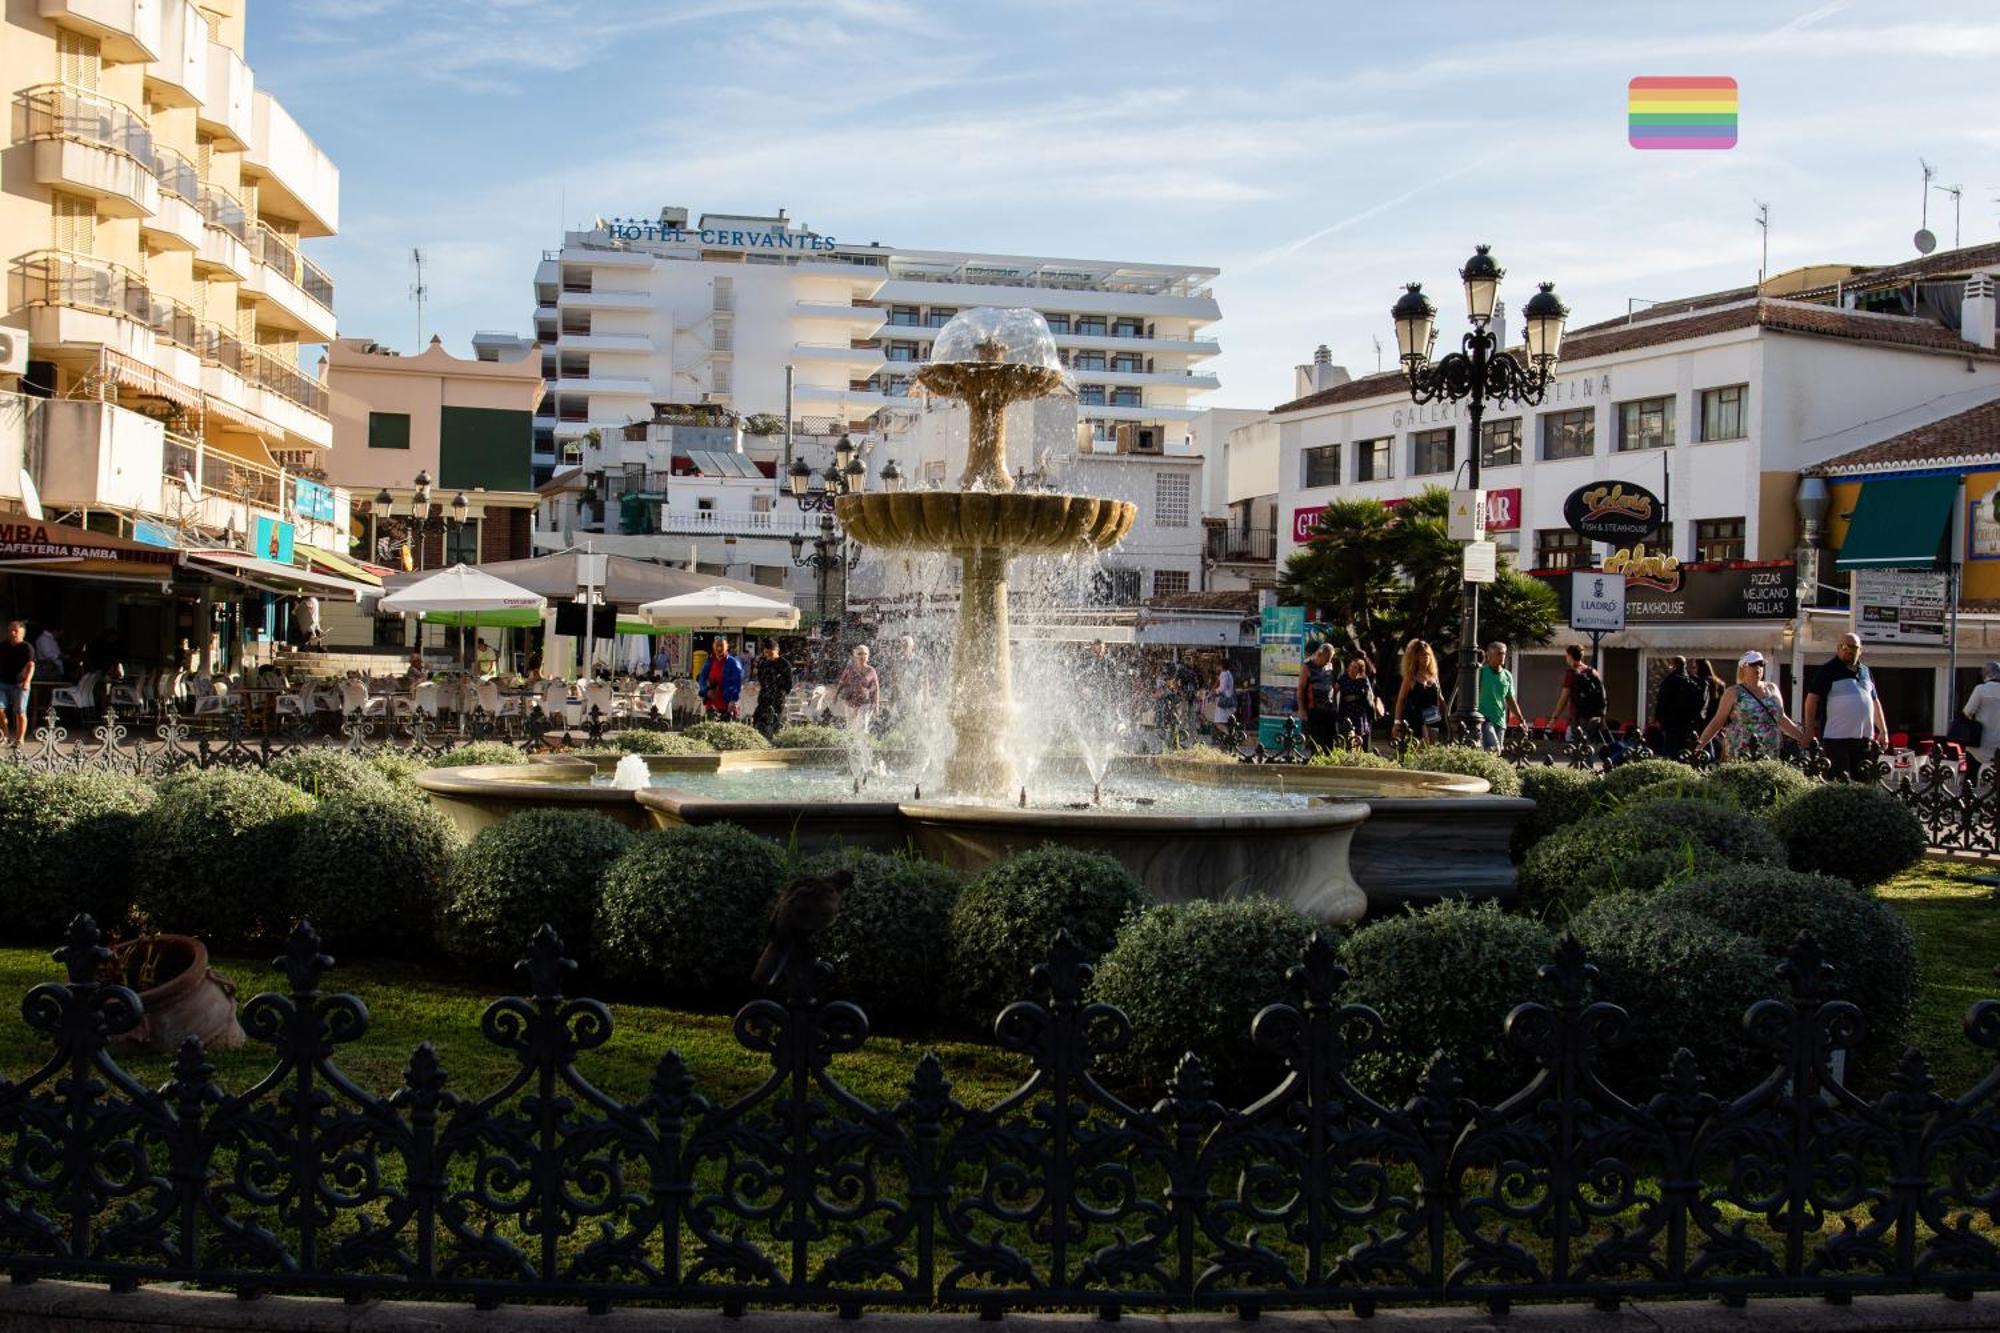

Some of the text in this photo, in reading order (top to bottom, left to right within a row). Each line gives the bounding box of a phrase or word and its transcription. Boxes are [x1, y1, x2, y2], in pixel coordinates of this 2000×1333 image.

[609, 224, 836, 251] HOTEL CERVANTES
[1604, 524, 1648, 533] STEAKHOUSE
[72, 548, 118, 560] SAMBA
[1751, 573, 1781, 585] PIZZAS
[1743, 587, 1789, 600] MEJICANO
[1626, 601, 1685, 615] STEAKHOUSE
[1747, 602, 1784, 614] PAELLAS
